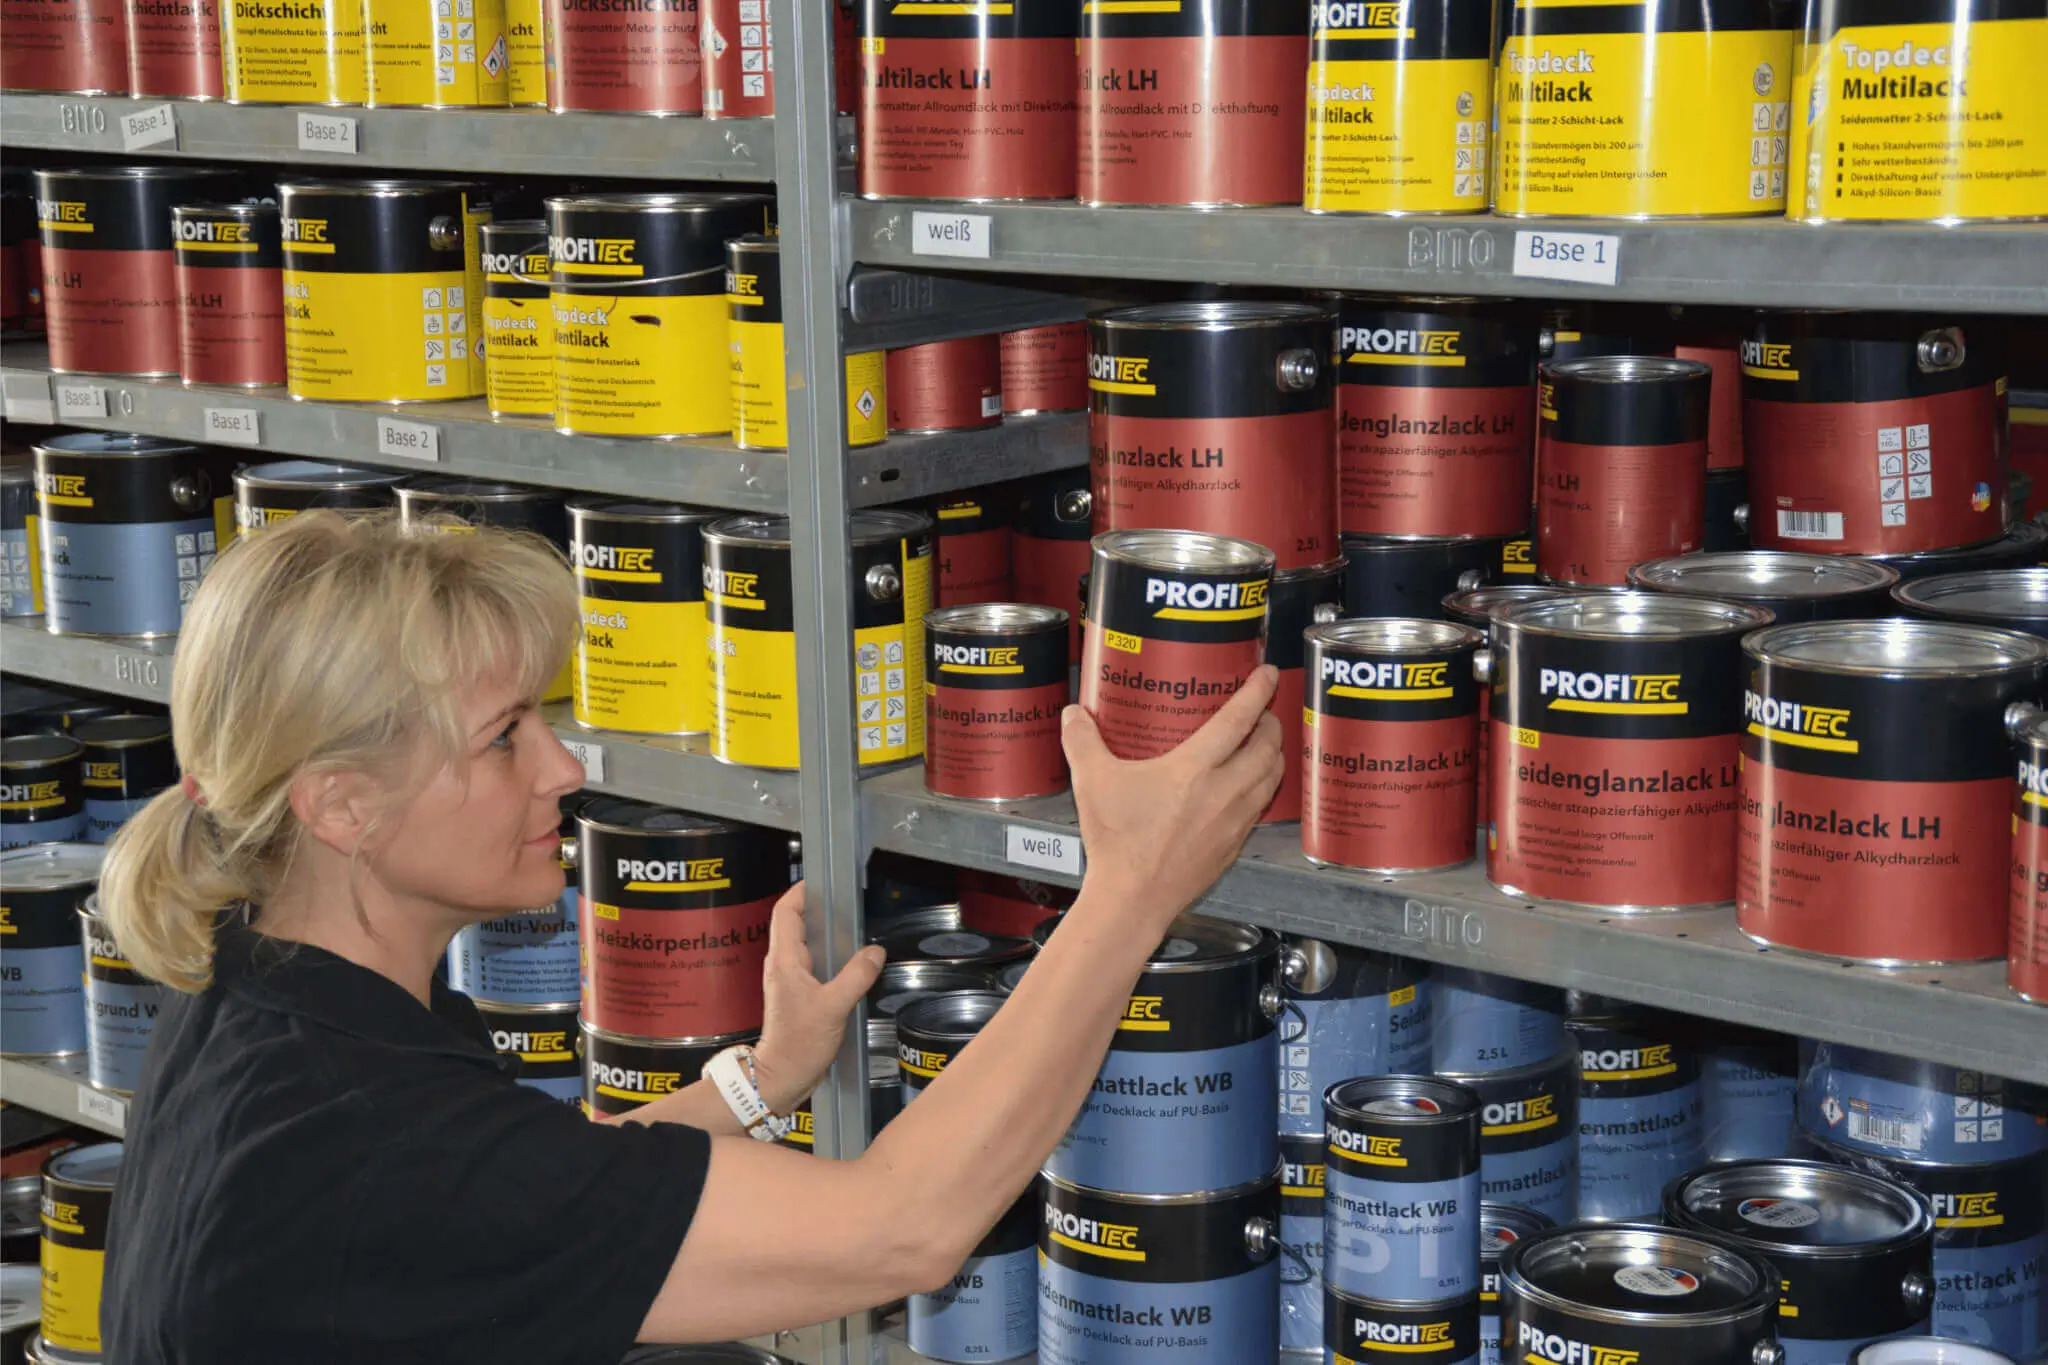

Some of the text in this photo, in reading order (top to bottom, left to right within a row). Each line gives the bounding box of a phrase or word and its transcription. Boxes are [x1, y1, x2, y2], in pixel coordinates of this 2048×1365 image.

[236, 1, 328, 20] Dickschich
[1128, 69, 1157, 91] LH
[1167, 103, 1189, 115] mit
[1191, 102, 1280, 117] Dekthaftung
[1310, 107, 1374, 124] Mltilack
[1552, 115, 1624, 126] 2-Schicht-Lack
[1840, 113, 1911, 125] Seidenmatter
[129, 108, 169, 136] Base 1
[305, 121, 349, 141] Base 2
[1593, 141, 1607, 150] bis
[1609, 141, 1626, 150] 200
[928, 218, 971, 242] weiß
[1531, 235, 1607, 264] Base 1
[1341, 326, 1461, 355] PROFITEC
[65, 389, 101, 406] Base 1
[211, 413, 252, 431] Base 1
[386, 427, 429, 449] Base 2
[1191, 447, 1224, 469] LH
[1155, 479, 1241, 494] Alkydharzlack
[1557, 474, 1580, 492] LH
[569, 540, 655, 571] POFITEC
[1145, 577, 1269, 610] PROFITEC
[1107, 632, 1138, 651] P 320
[934, 642, 1019, 666] PROFITEC
[1320, 656, 1450, 688] PROFITEC
[1539, 668, 1682, 702] PROFITEC
[1744, 689, 1851, 738] PROFITEC
[1303, 744, 1449, 775] eienglanzlack
[1512, 762, 1714, 798] eidenglanzlack
[1565, 803, 1681, 821] strapazierfähiger
[1743, 788, 1942, 841] denlanzlack LH
[1022, 837, 1063, 859] weiß
[1853, 849, 1961, 868] Alkydharzlack
[616, 857, 724, 882] PROFITEC
[1404, 898, 1487, 949] BITO
[594, 927, 742, 957] Heizkörperlack
[1477, 1047, 1498, 1061] 2,5
[591, 1059, 681, 1093] PROFITEC
[1194, 1071, 1234, 1094] WB
[1102, 1102, 1230, 1119] Decklack auf PU-Basis
[1326, 1121, 1403, 1158] PROFITEC
[1427, 1199, 1458, 1217] WB
[1044, 1200, 1139, 1250] PROFITEC
[1170, 1304, 1213, 1328] WB
[1083, 1326, 1210, 1349] Decklack auf PU-Basis
[1354, 1318, 1451, 1343] PROFITEC
